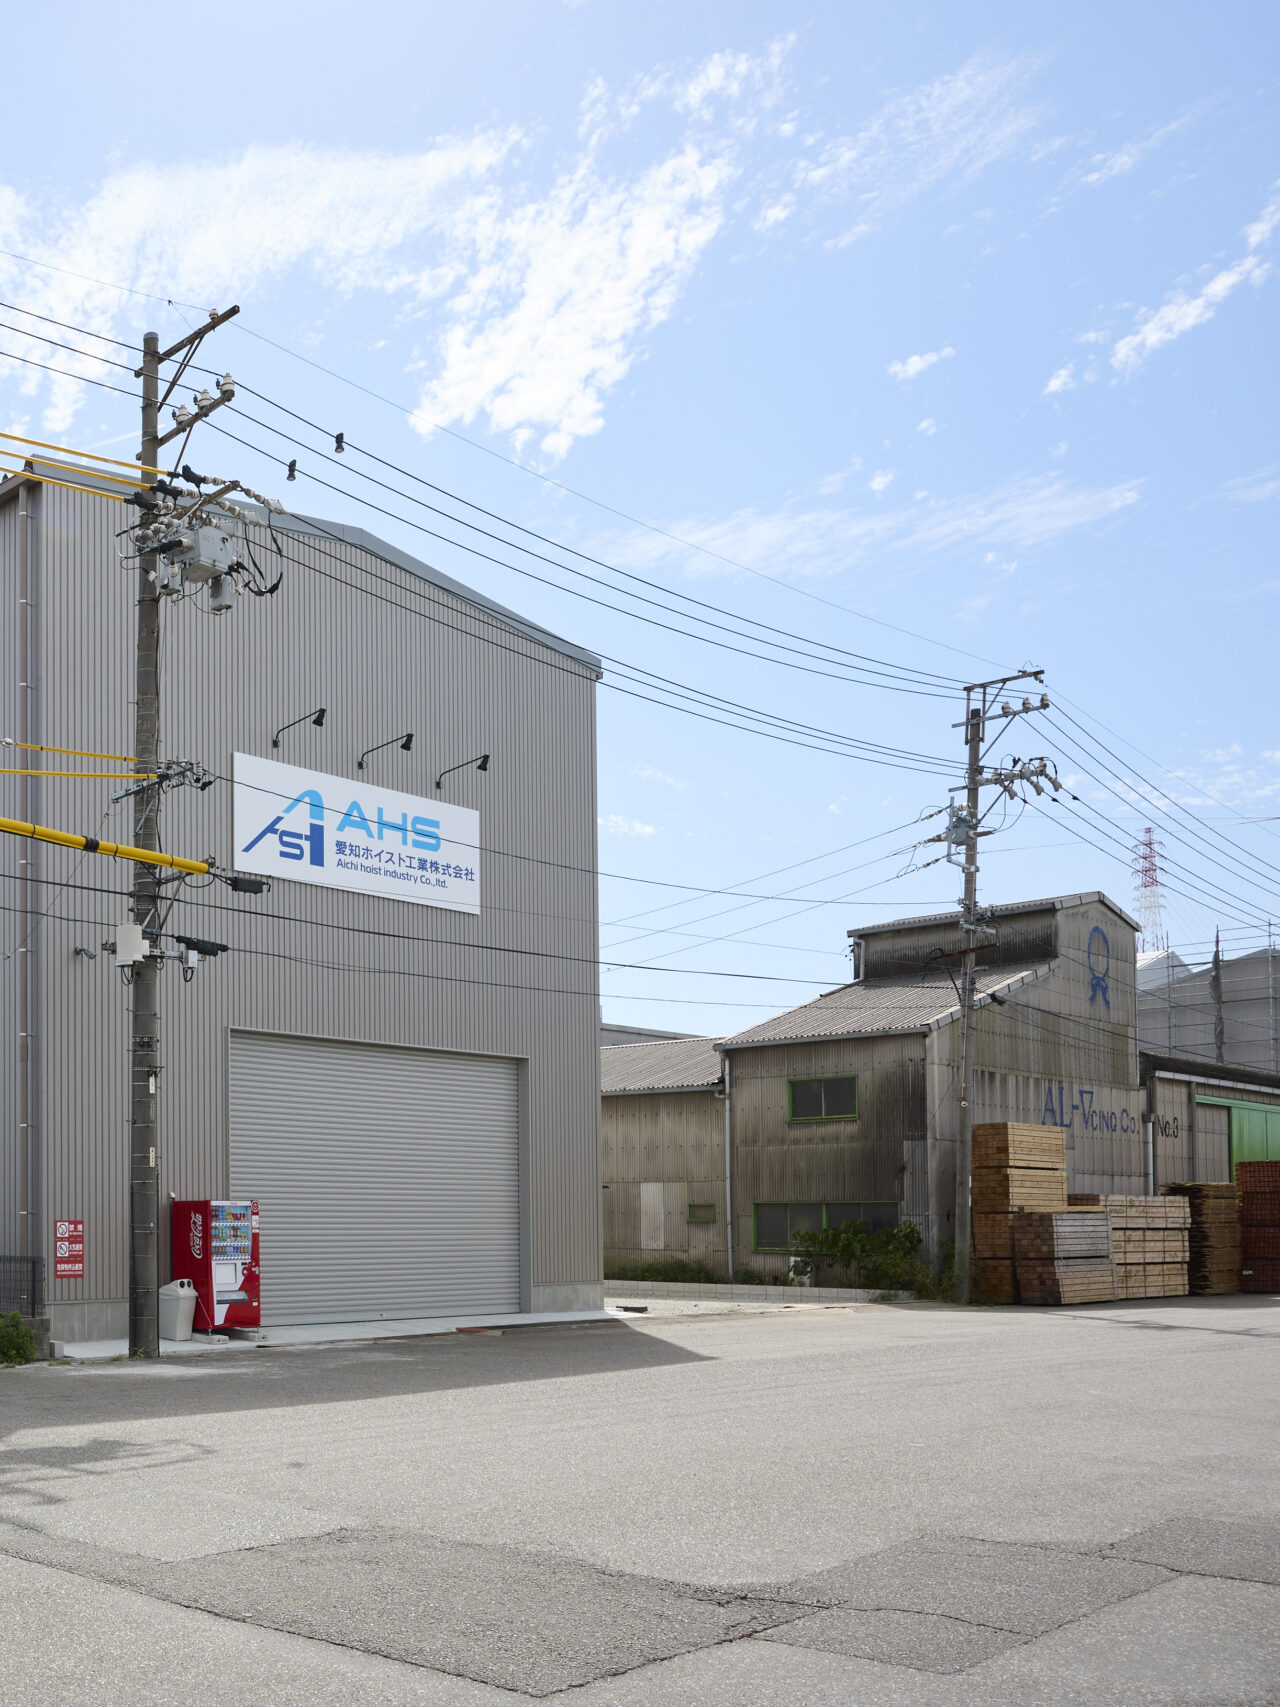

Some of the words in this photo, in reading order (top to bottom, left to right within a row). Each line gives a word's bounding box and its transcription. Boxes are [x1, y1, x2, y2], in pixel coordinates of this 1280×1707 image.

[336, 800, 442, 852] AHS
[335, 840, 476, 882] 愛知ホイスト工業株式会社
[336, 858, 359, 871] Aichi
[360, 863, 382, 876] hoist
[383, 867, 418, 884] industry
[1157, 1114, 1179, 1138] No.3
